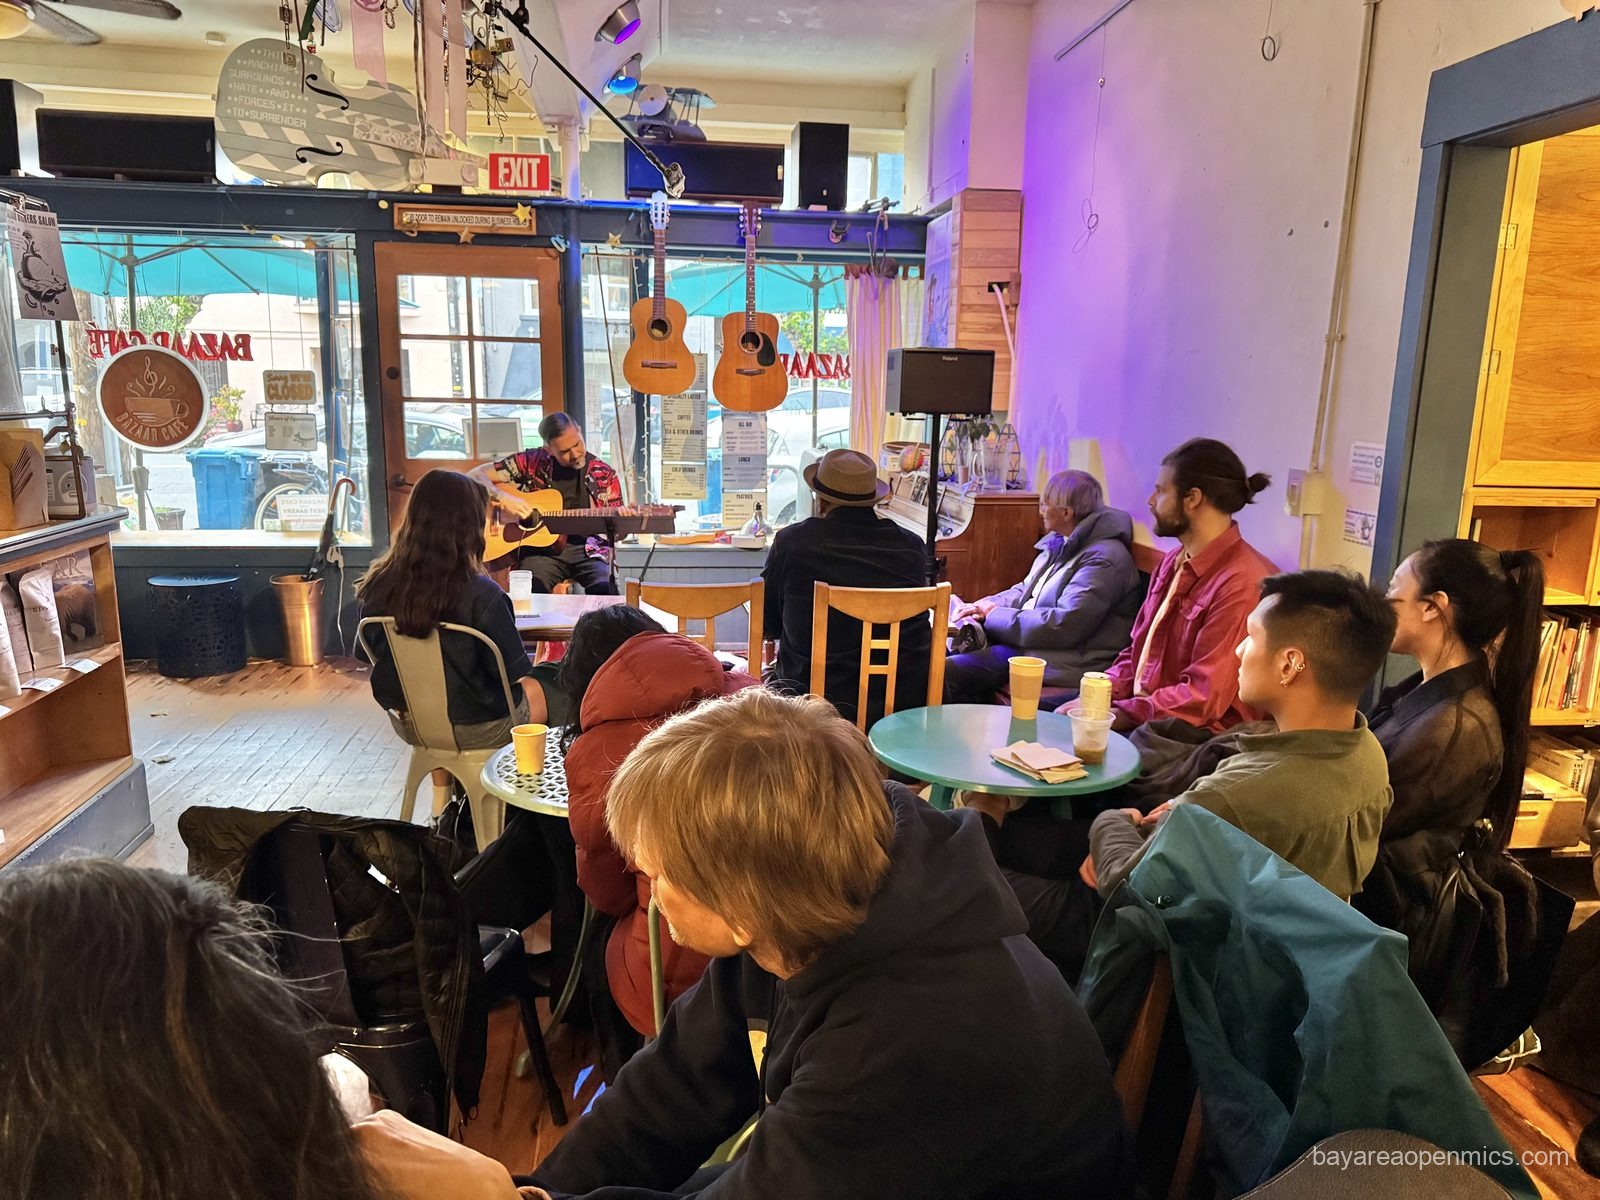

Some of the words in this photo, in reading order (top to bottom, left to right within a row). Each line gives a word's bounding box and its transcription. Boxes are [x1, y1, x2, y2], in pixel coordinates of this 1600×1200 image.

[263, 49, 286, 61] THI
[228, 69, 285, 86] SURROUNDS
[233, 82, 258, 94] HATE
[269, 88, 290, 99] AND
[239, 95, 276, 110] FORCES
[282, 103, 295, 112] IT
[233, 107, 244, 117] TO
[249, 110, 307, 128] SURRENDER
[498, 156, 541, 189] EXIT
[38, 215, 56, 227] SALON
[415, 213, 427, 223] DOOR
[428, 214, 435, 223] TO
[435, 214, 451, 224] REMAIN
[451, 215, 474, 225] UNLOCKED
[474, 215, 491, 225] DURING
[491, 217, 512, 226] BUSINESS
[512, 217, 528, 227] HOS
[266, 383, 314, 401] CLOSED
[116, 412, 159, 442] BAZAAR
